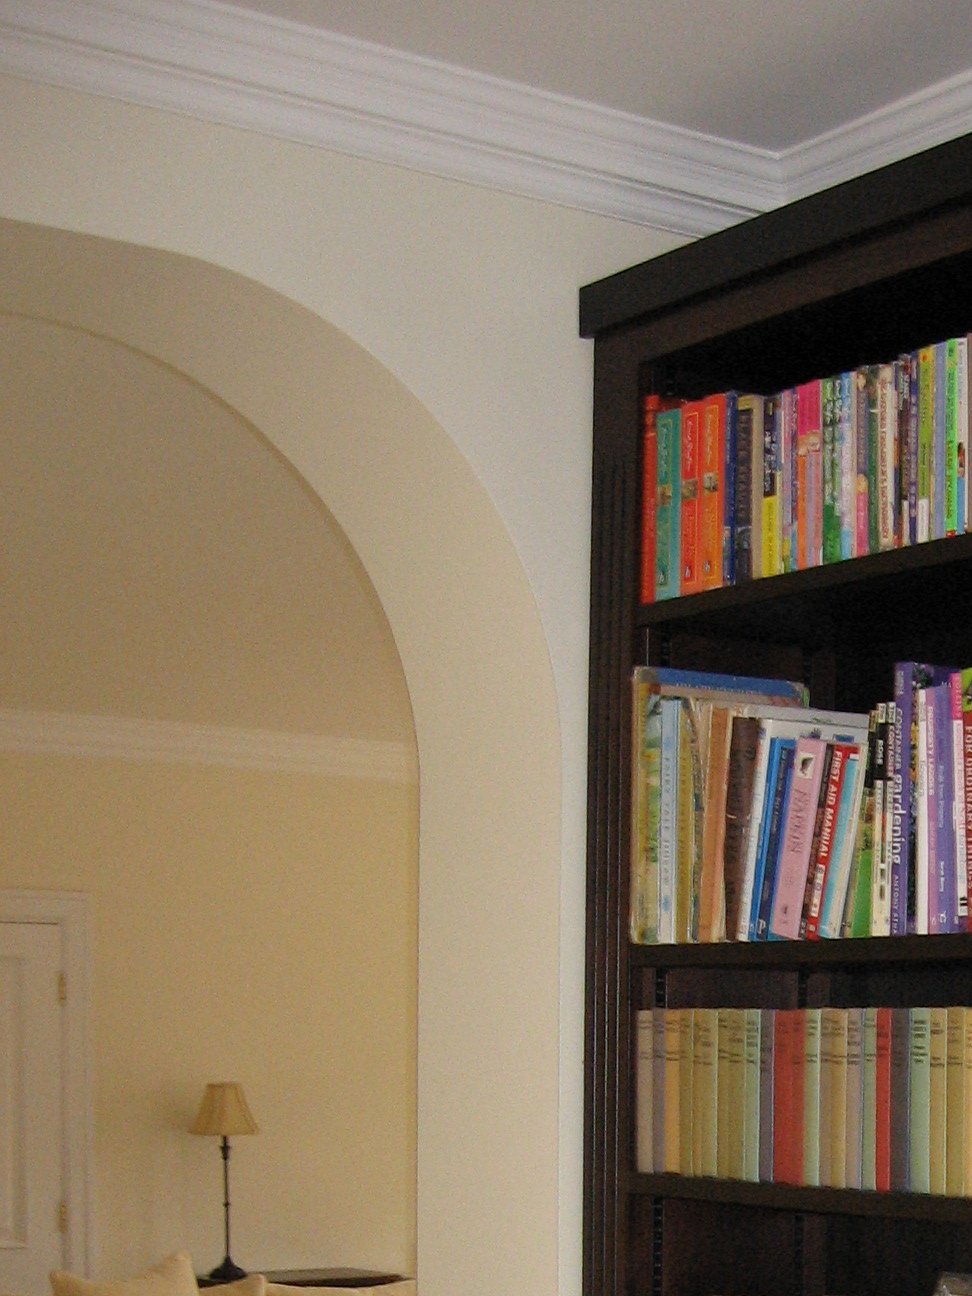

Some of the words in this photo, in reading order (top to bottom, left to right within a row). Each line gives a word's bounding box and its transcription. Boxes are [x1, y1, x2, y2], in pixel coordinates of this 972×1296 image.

[876, 739, 884, 765] ROSE
[894, 707, 903, 771] CONTAINER
[830, 750, 843, 783] FIRST
[826, 784, 838, 806] AID
[819, 807, 835, 858] MANUAL
[891, 773, 906, 865] gardening
